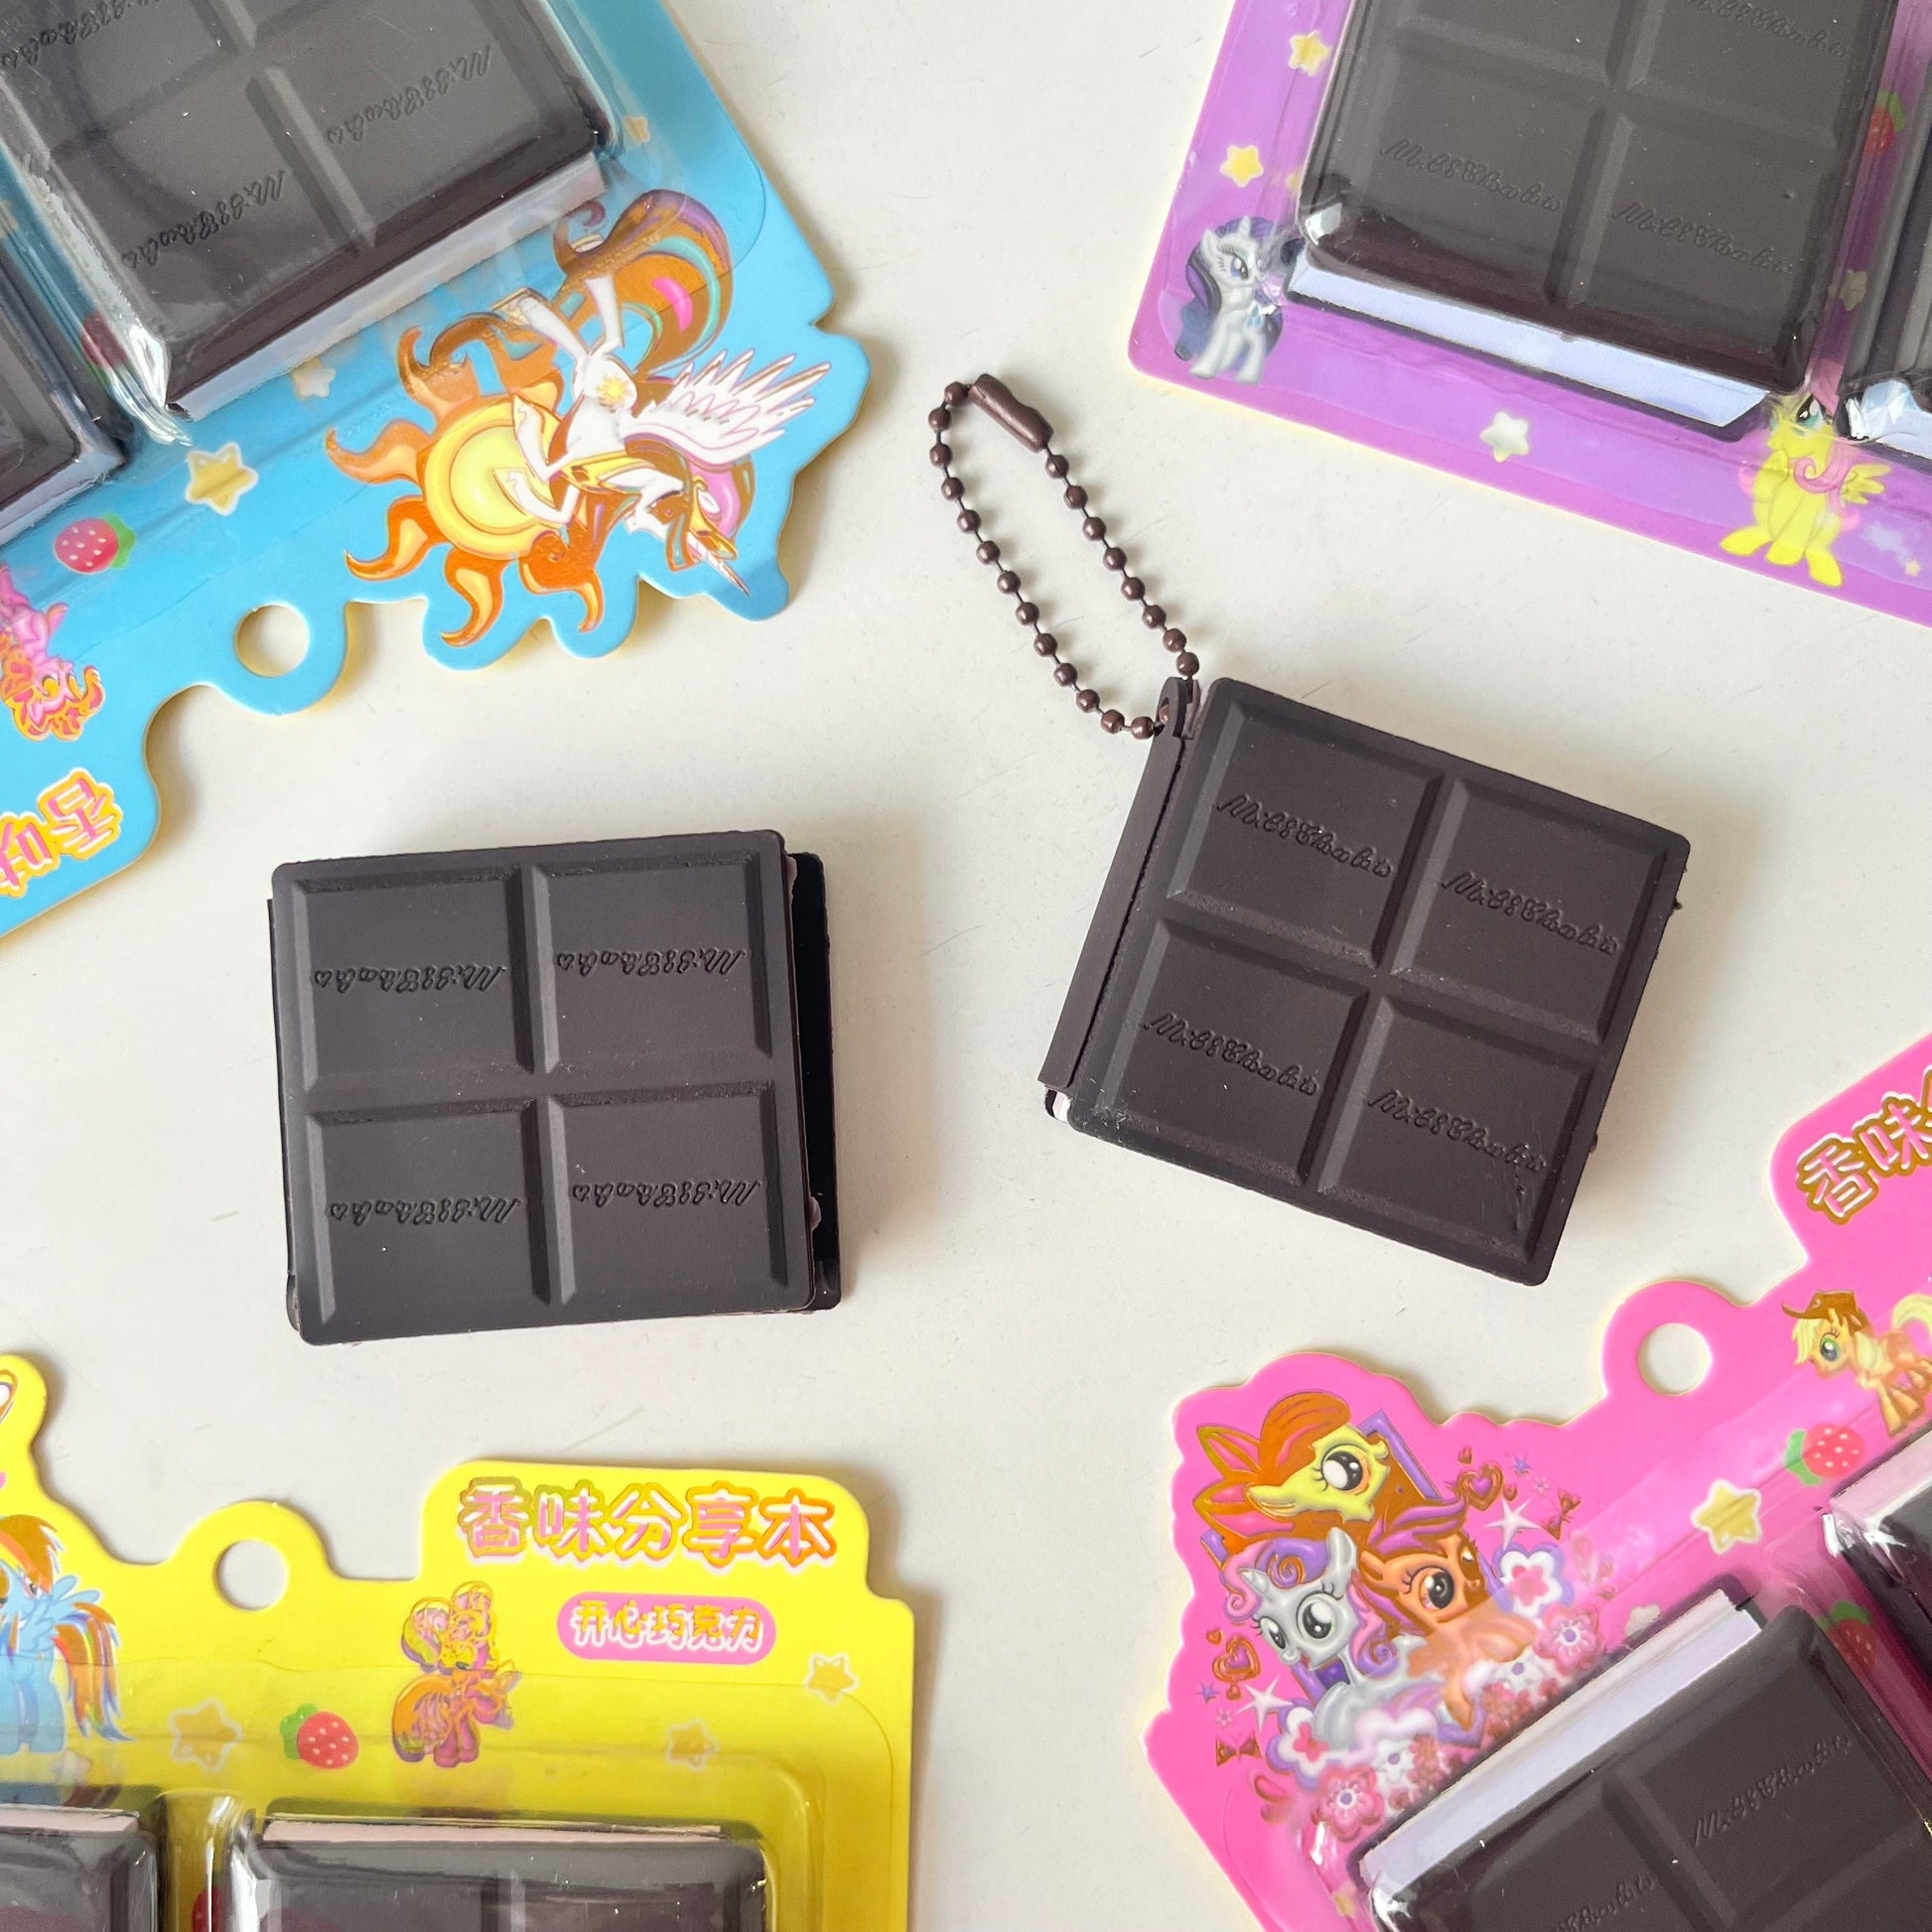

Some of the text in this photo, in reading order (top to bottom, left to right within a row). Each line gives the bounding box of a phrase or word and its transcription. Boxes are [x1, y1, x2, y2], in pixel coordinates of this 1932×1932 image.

[1796, 1065, 1932, 1224] 香味
[459, 1476, 837, 1569] 香味分享本
[572, 1599, 763, 1652] 开心巧克力
